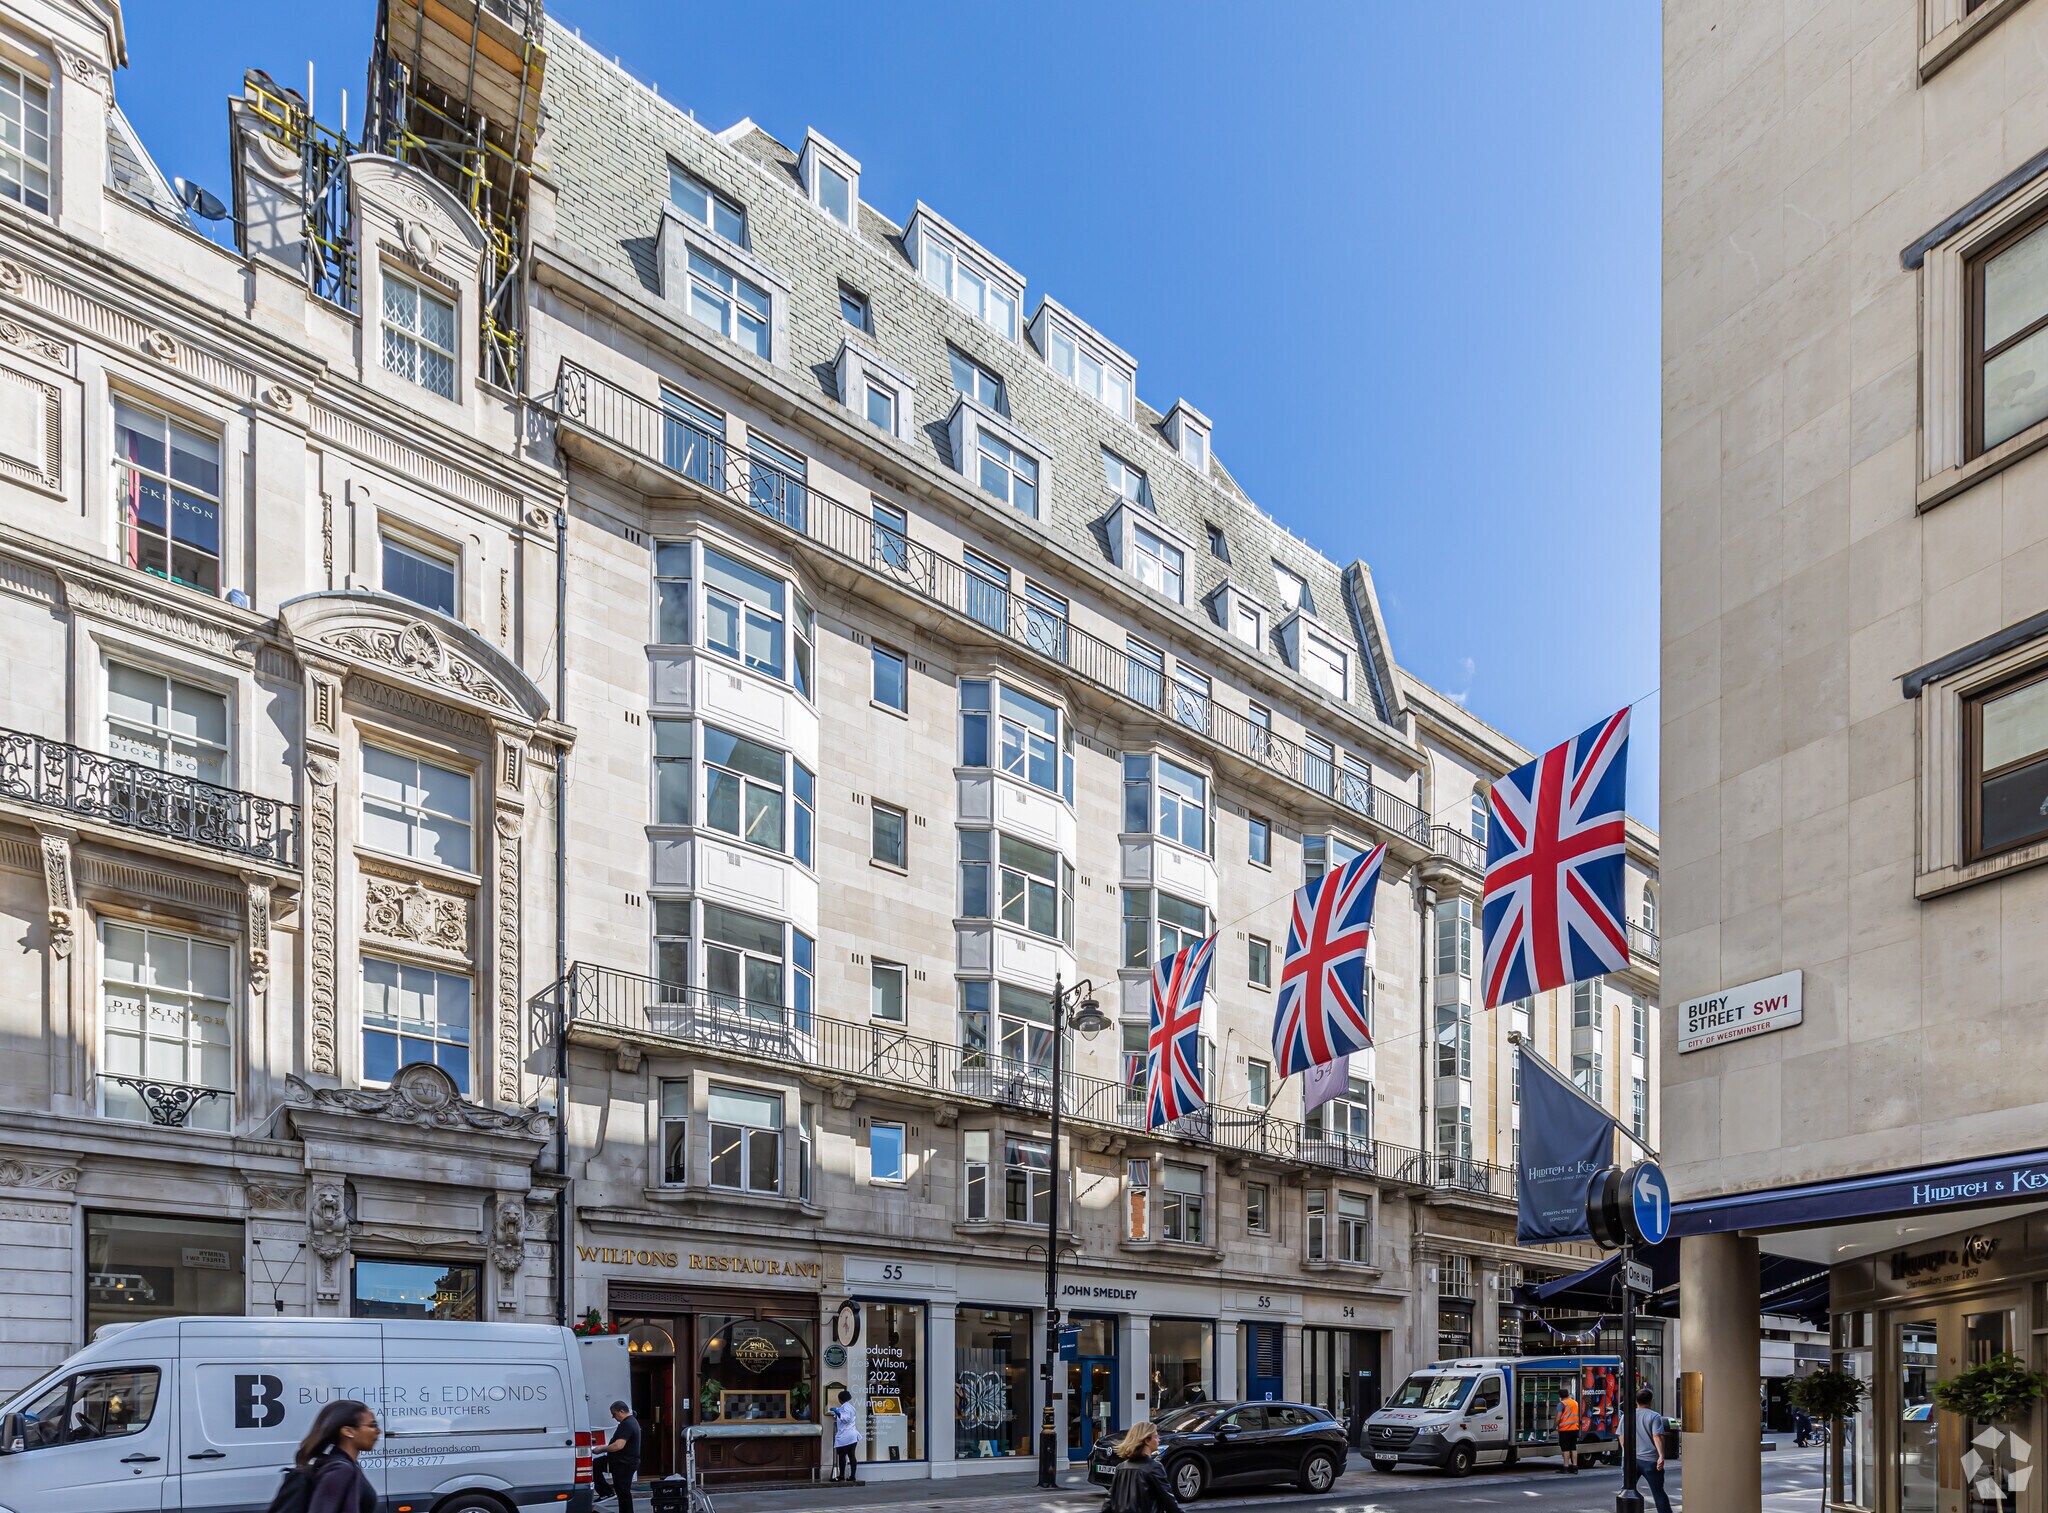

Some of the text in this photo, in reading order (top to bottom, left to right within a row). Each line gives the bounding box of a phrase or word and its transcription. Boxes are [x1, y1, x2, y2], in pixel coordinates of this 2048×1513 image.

[1688, 996, 1729, 1019] BURY
[1689, 994, 1788, 1033] STREET SW1
[1688, 1021, 1771, 1048] CITY OF WESTMINSTER
[1314, 1060, 1333, 1082] 54
[1528, 1166, 1565, 1181] HILDITCH
[1577, 1160, 1599, 1174] KEY
[1912, 1181, 1988, 1205] HILDITCH
[1995, 1181, 2005, 1191] &
[1542, 1209, 1560, 1217] JERMYN
[577, 1245, 821, 1279] WILTONS RESTAURANT
[882, 1264, 903, 1280] 55
[1628, 1266, 1651, 1288] One way
[1961, 1267, 1979, 1280] 1899
[1062, 1284, 1138, 1300] JOHN SMEDLEY
[1258, 1295, 1271, 1308] 55
[1343, 1306, 1355, 1318] 54
[735, 1350, 779, 1358] WILTONS
[872, 1357, 908, 1370] Wilson,
[869, 1371, 896, 1382] 2022
[299, 1385, 548, 1405] BUTCHER & EDMONDS
[851, 1383, 900, 1395] Craft Prize
[234, 1374, 286, 1429] B
[431, 1405, 491, 1416] BUTCHERS
[360, 1455, 446, 1469] 020 7582 8777
